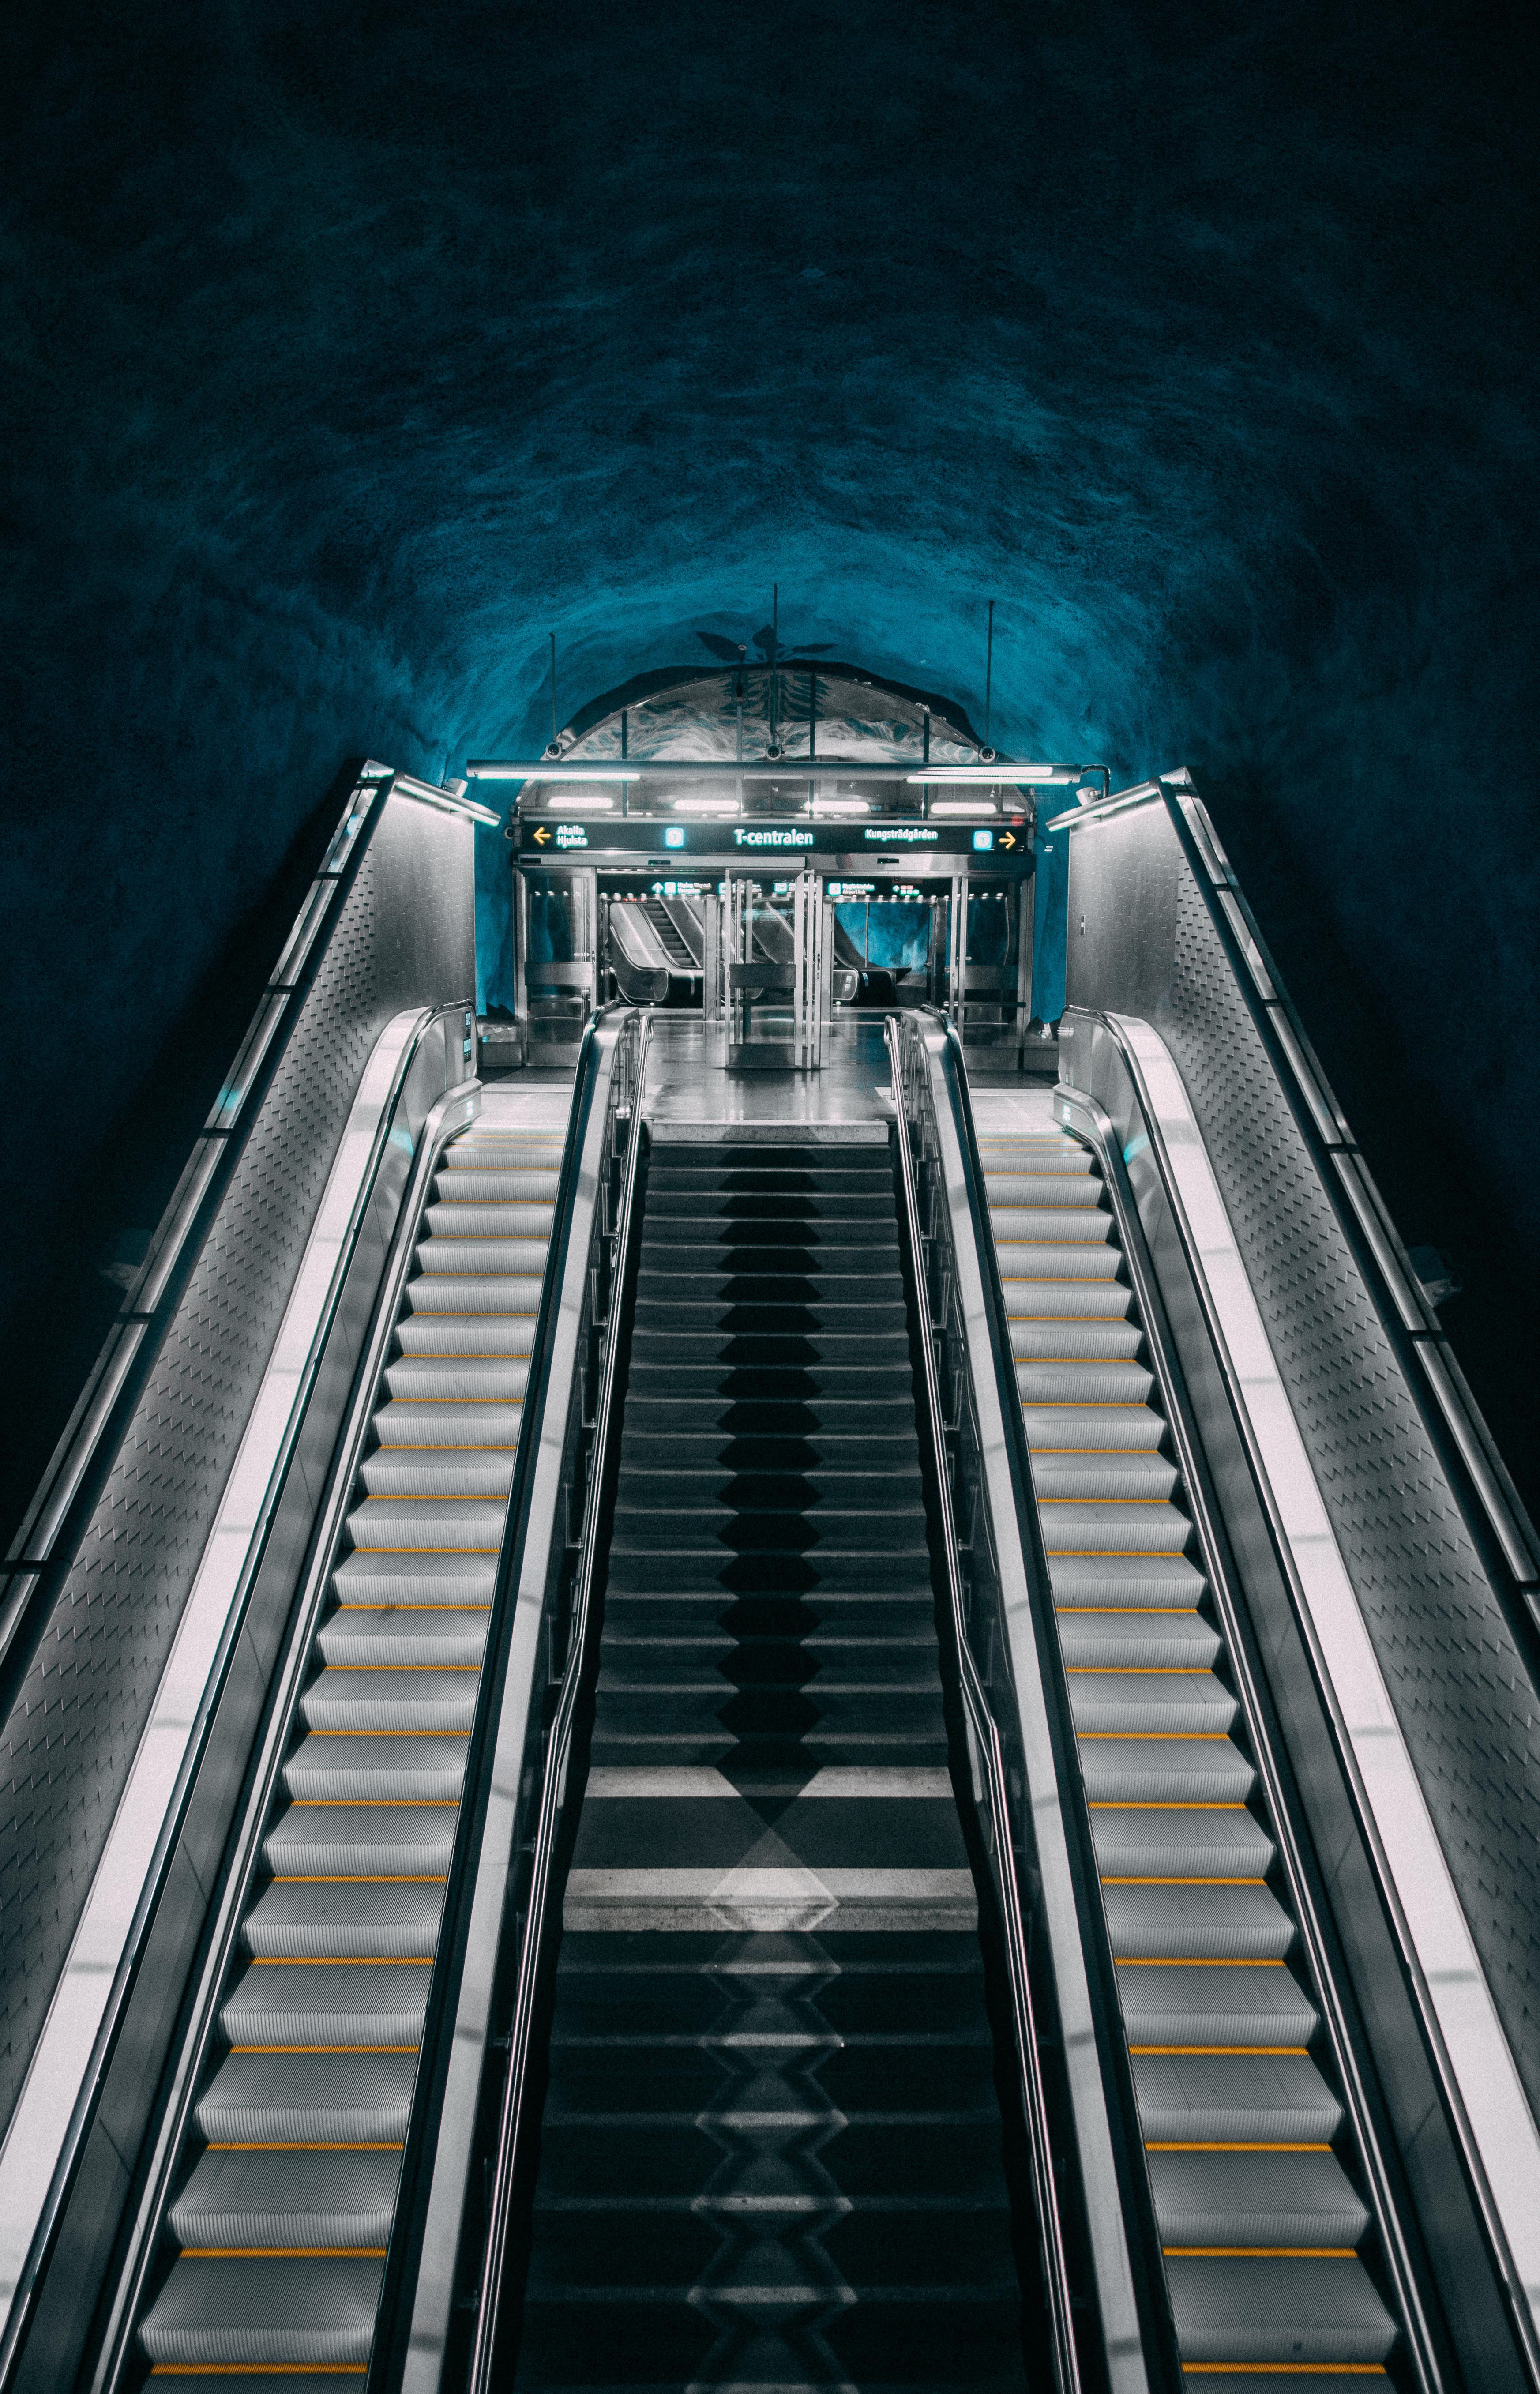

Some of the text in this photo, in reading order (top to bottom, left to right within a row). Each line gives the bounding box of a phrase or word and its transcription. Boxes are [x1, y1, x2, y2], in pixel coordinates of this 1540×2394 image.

[557, 825, 584, 835] Akalla
[735, 828, 813, 844] T-centralen
[866, 829, 937, 842] Kungsträdgården
[557, 835, 587, 848] Hjulsta
